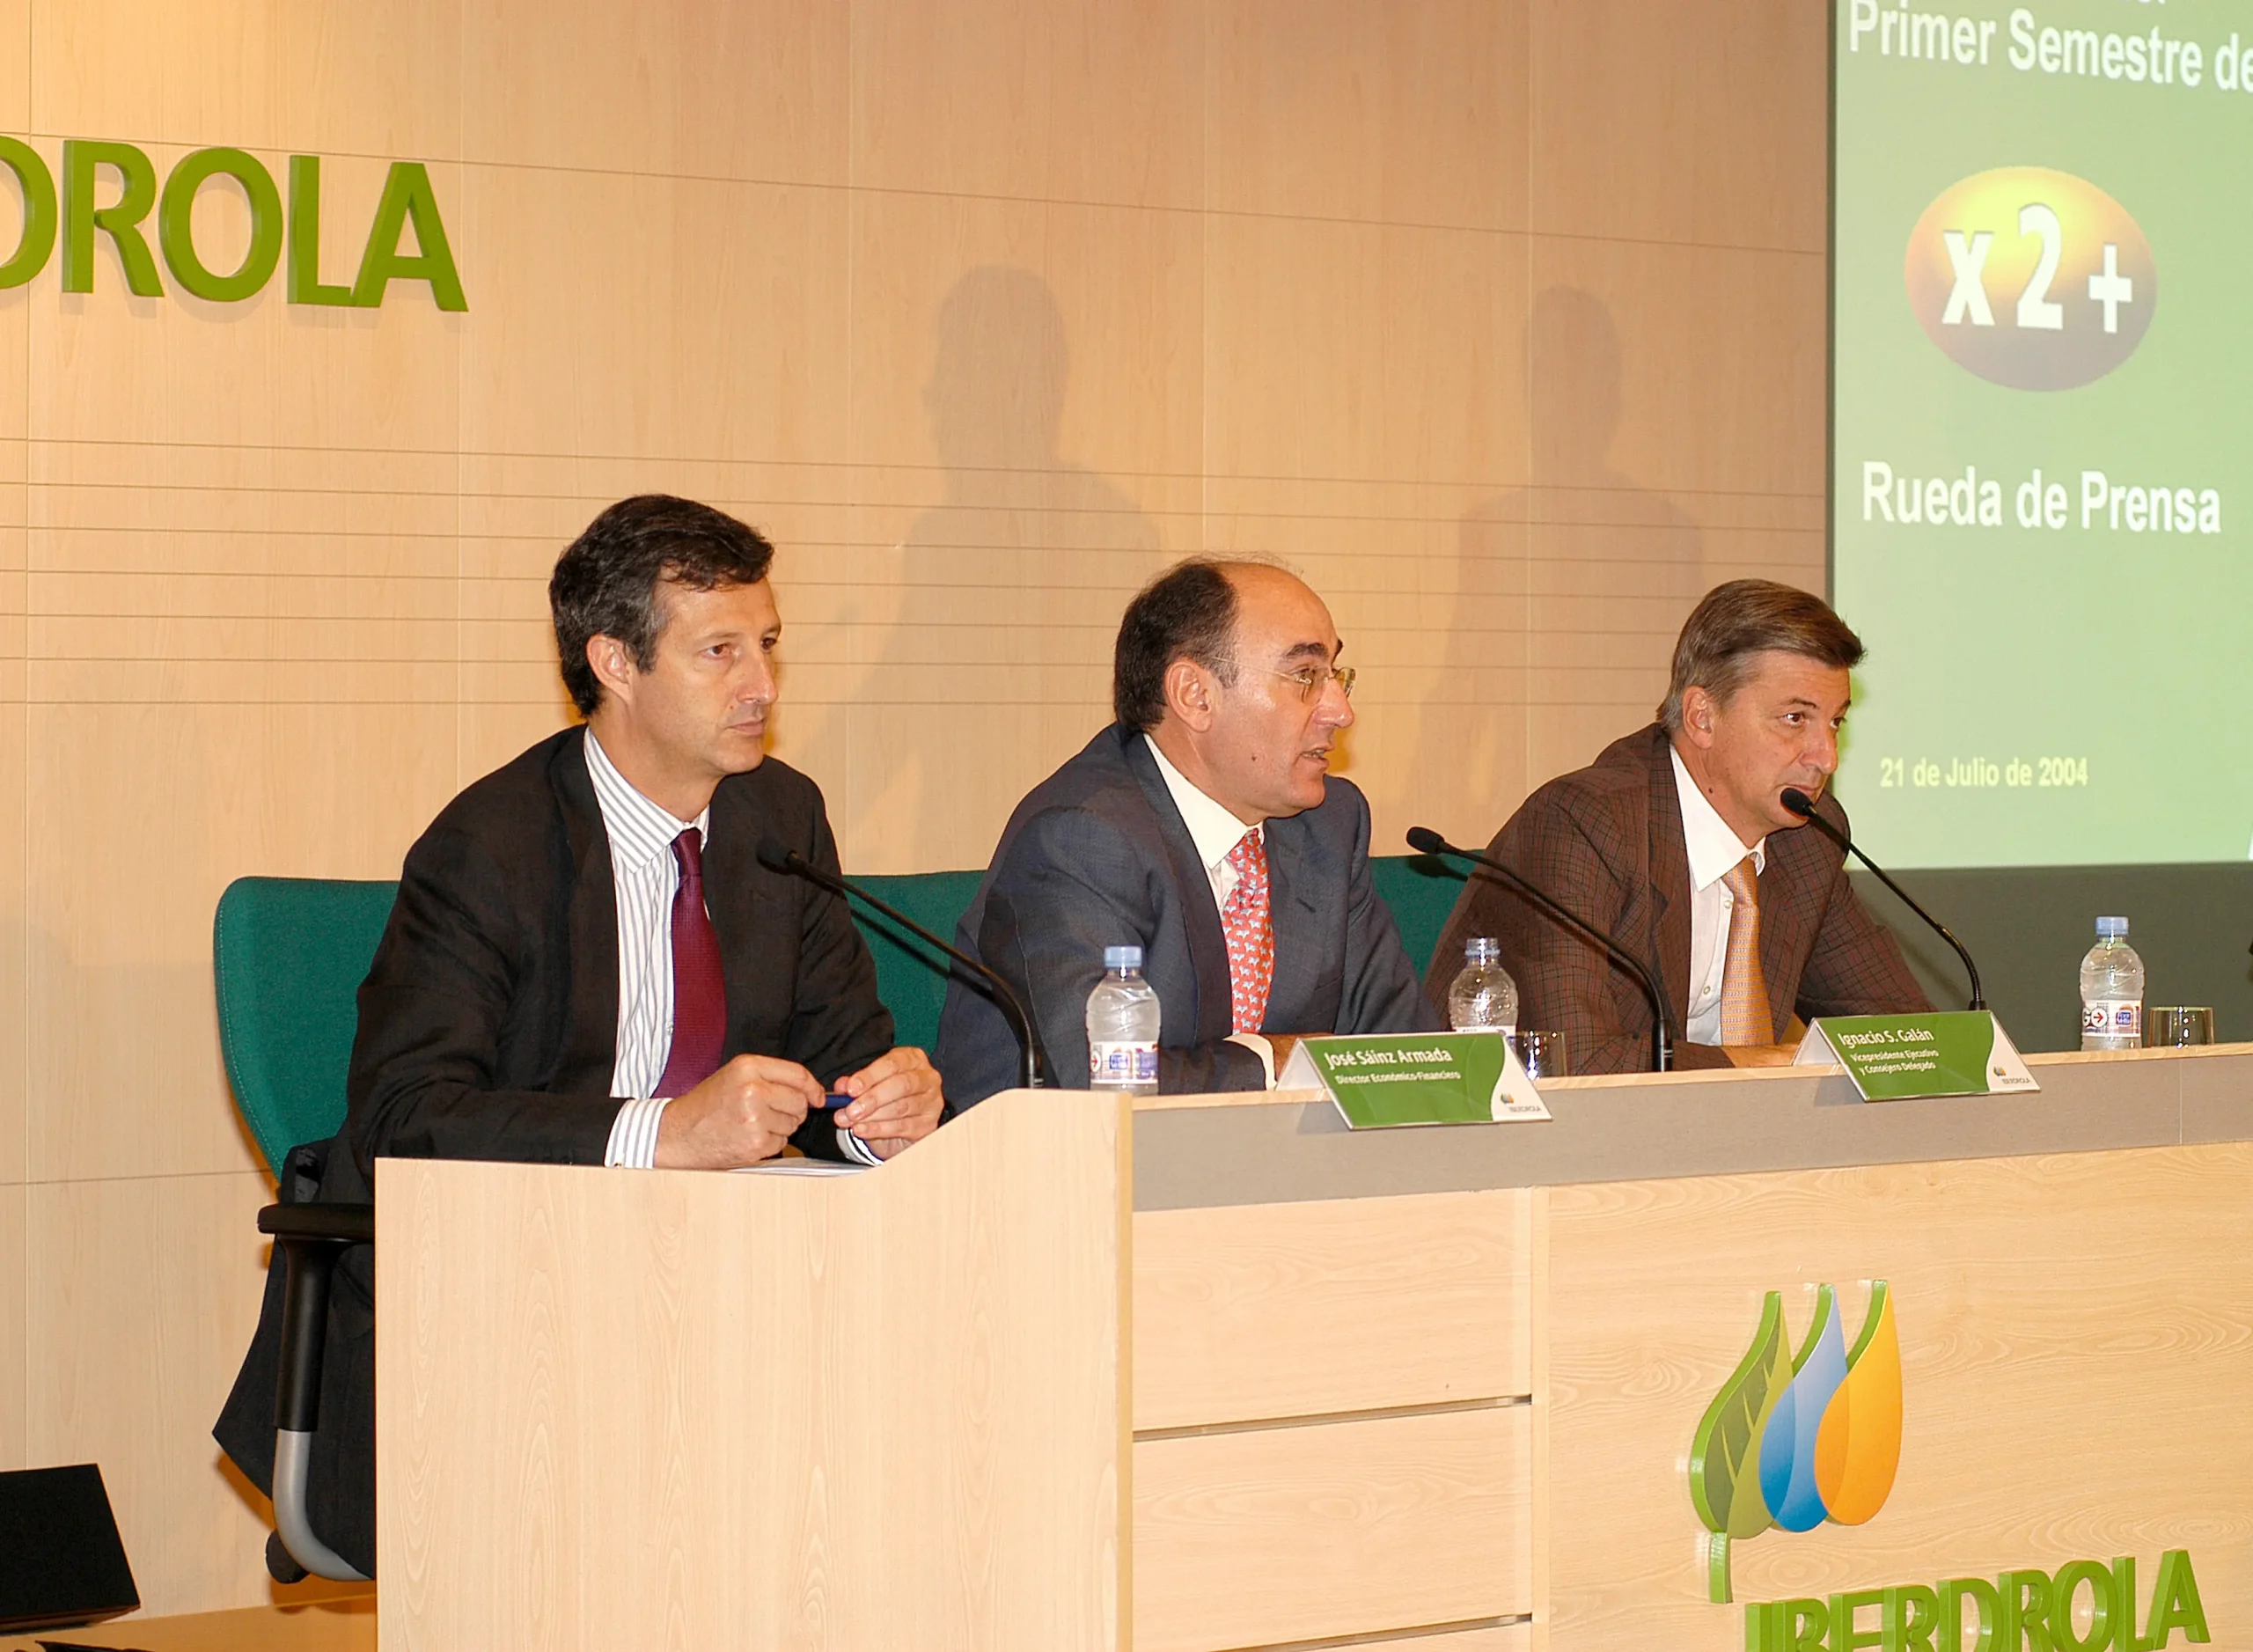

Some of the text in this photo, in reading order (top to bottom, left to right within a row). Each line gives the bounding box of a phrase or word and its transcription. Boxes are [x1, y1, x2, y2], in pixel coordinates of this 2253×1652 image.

[1850, 0, 1997, 65] Primer
[2007, 8, 2203, 87] Semestre
[2017, 202, 2063, 330] 2
[1863, 460, 2222, 534] Rueda de Prensa
[1880, 756, 2089, 787] 21 de Julio de 2004
[1838, 1028, 1934, 1048] Ignacio S. Galán
[1324, 1046, 1453, 1070] José Sáinz Armada
[1850, 1048, 1940, 1062] Vicepresidente Ejecutivo
[1334, 1074, 1371, 1084] Director
[1864, 1063, 1903, 1075] Consejero
[1901, 1061, 1936, 1072] Delegado
